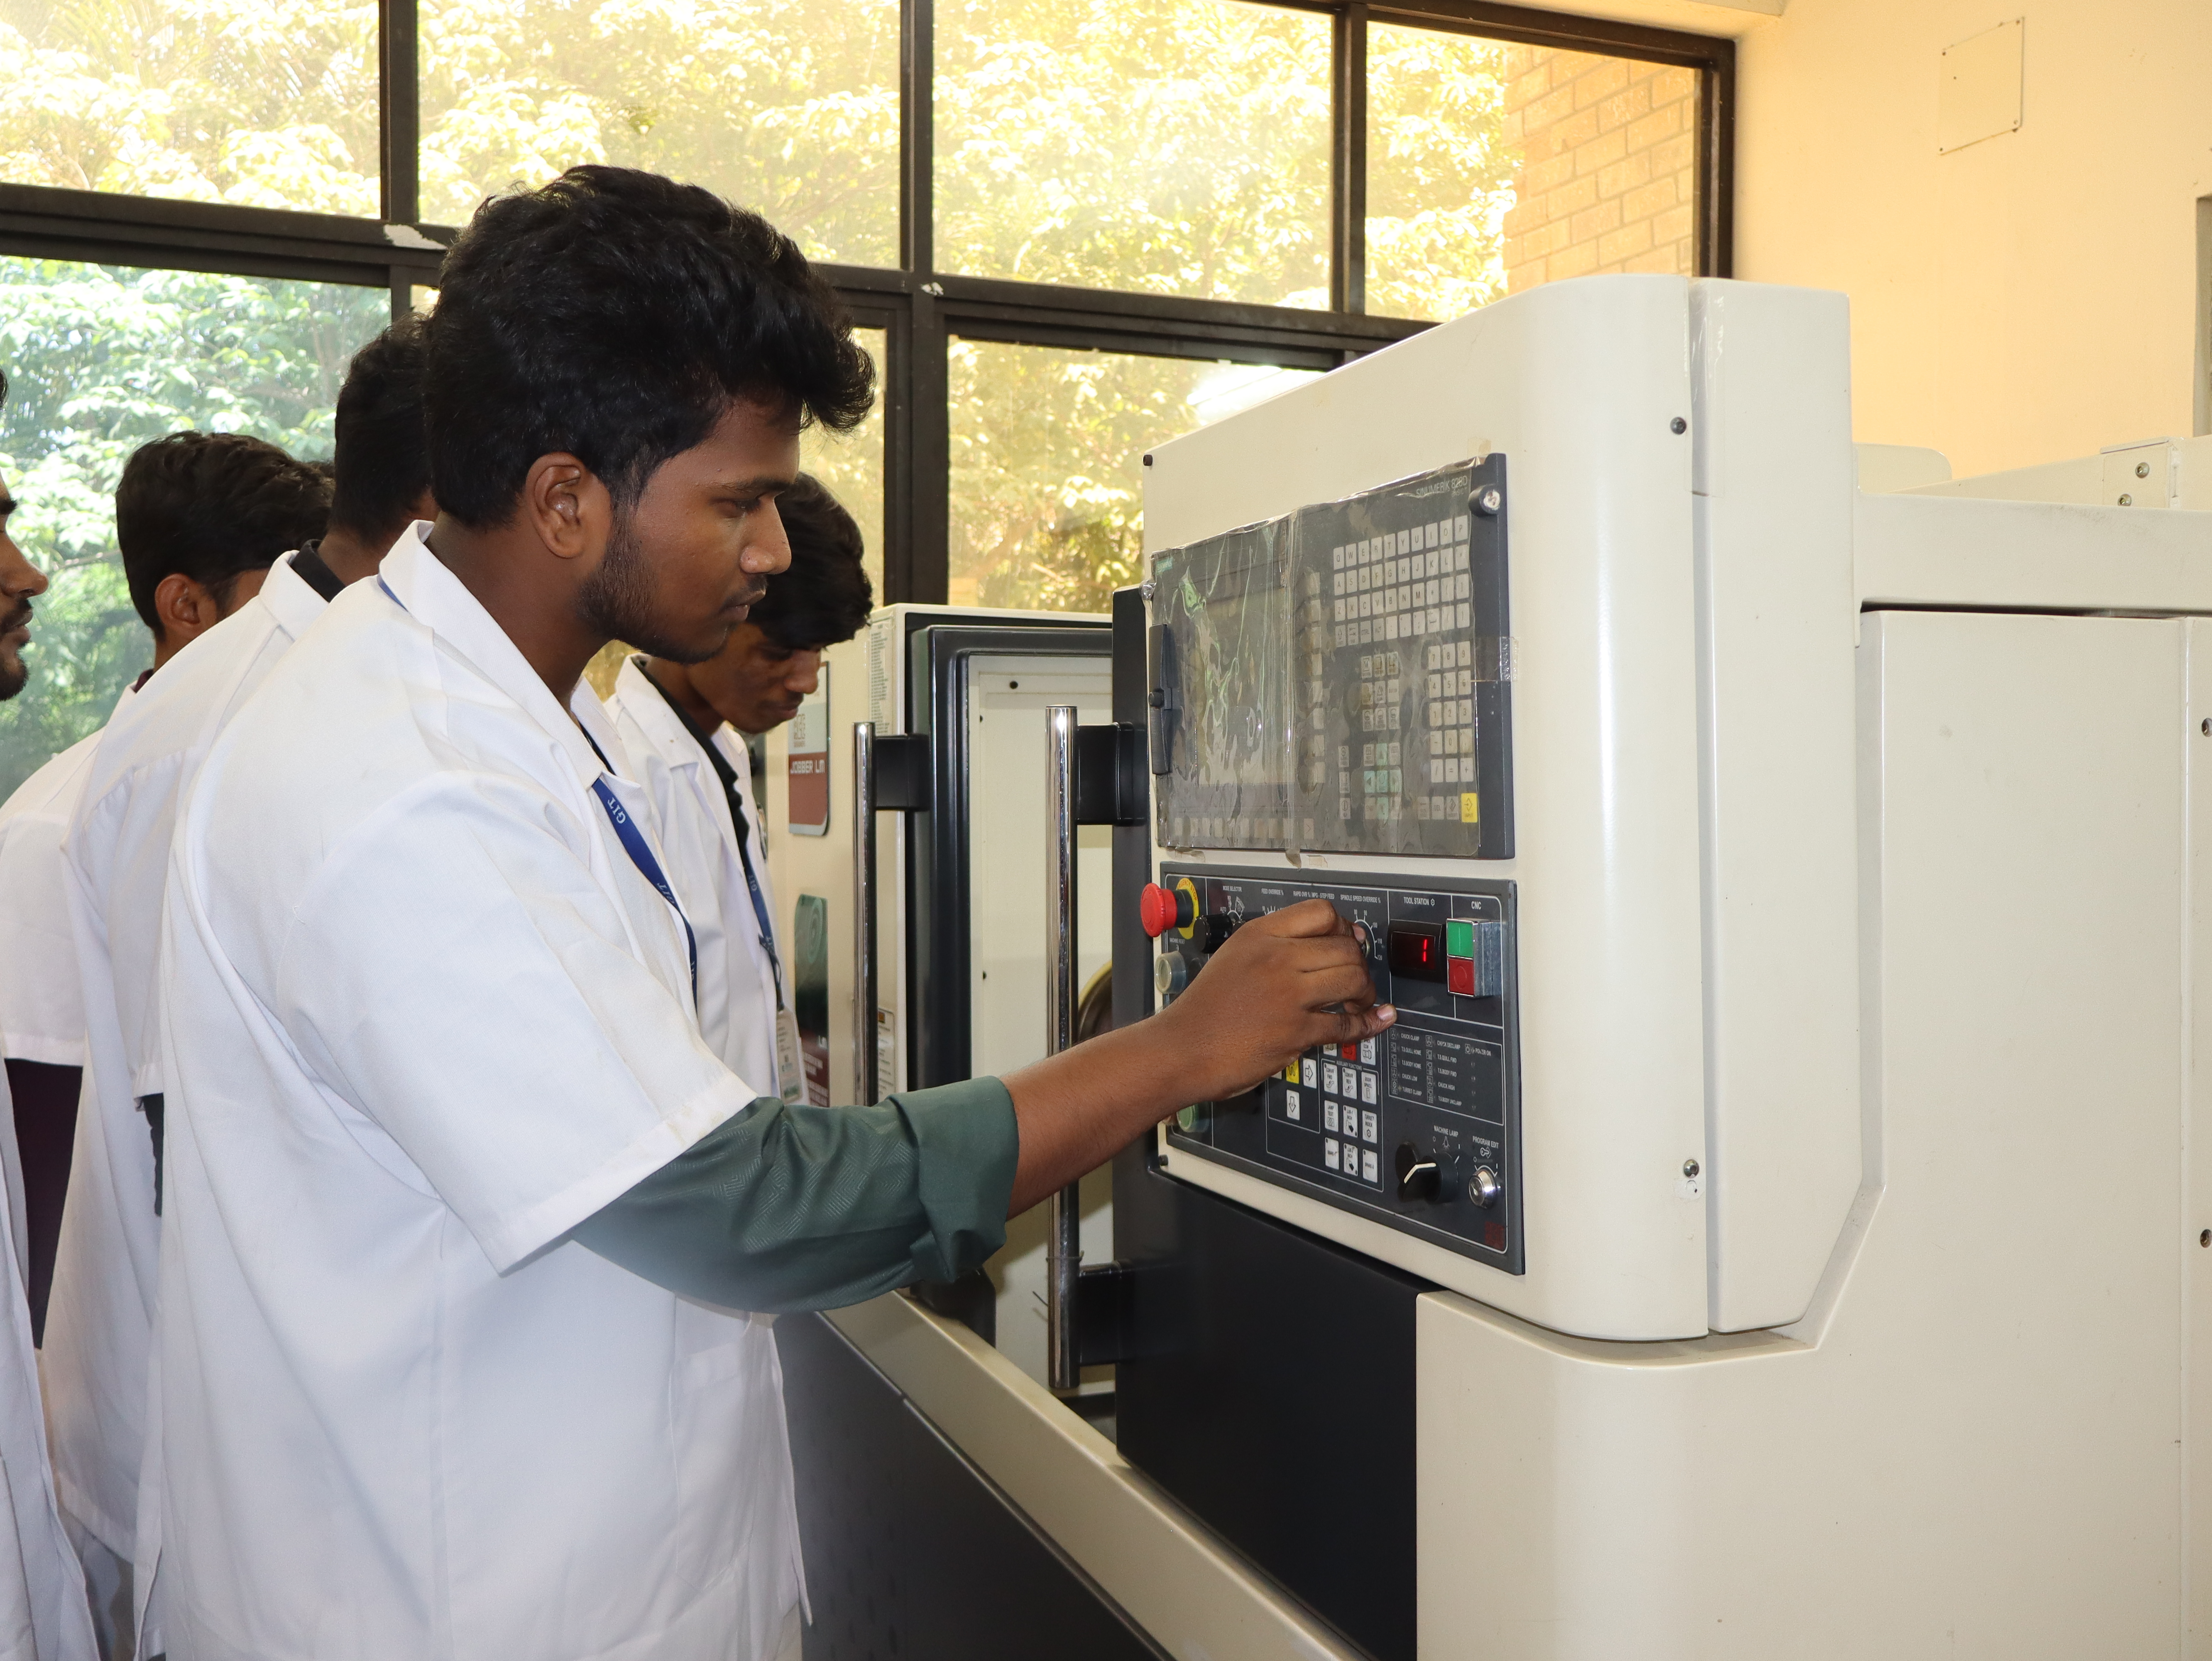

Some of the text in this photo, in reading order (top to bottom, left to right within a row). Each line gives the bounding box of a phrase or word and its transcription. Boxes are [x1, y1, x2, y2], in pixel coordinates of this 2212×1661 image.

[1416, 475, 1468, 497] SINUMERIK 828D
[1416, 563, 1419, 571] J
[790, 759, 825, 774] JOBBER LM
[607, 797, 626, 824] GIT
[1414, 897, 1429, 906] STATION
[1471, 901, 1482, 909] CNC
[1423, 939, 1427, 962] 1
[1434, 1125, 1458, 1137] MACHINE LAMP
[1473, 1136, 1490, 1147] PROGRAM
